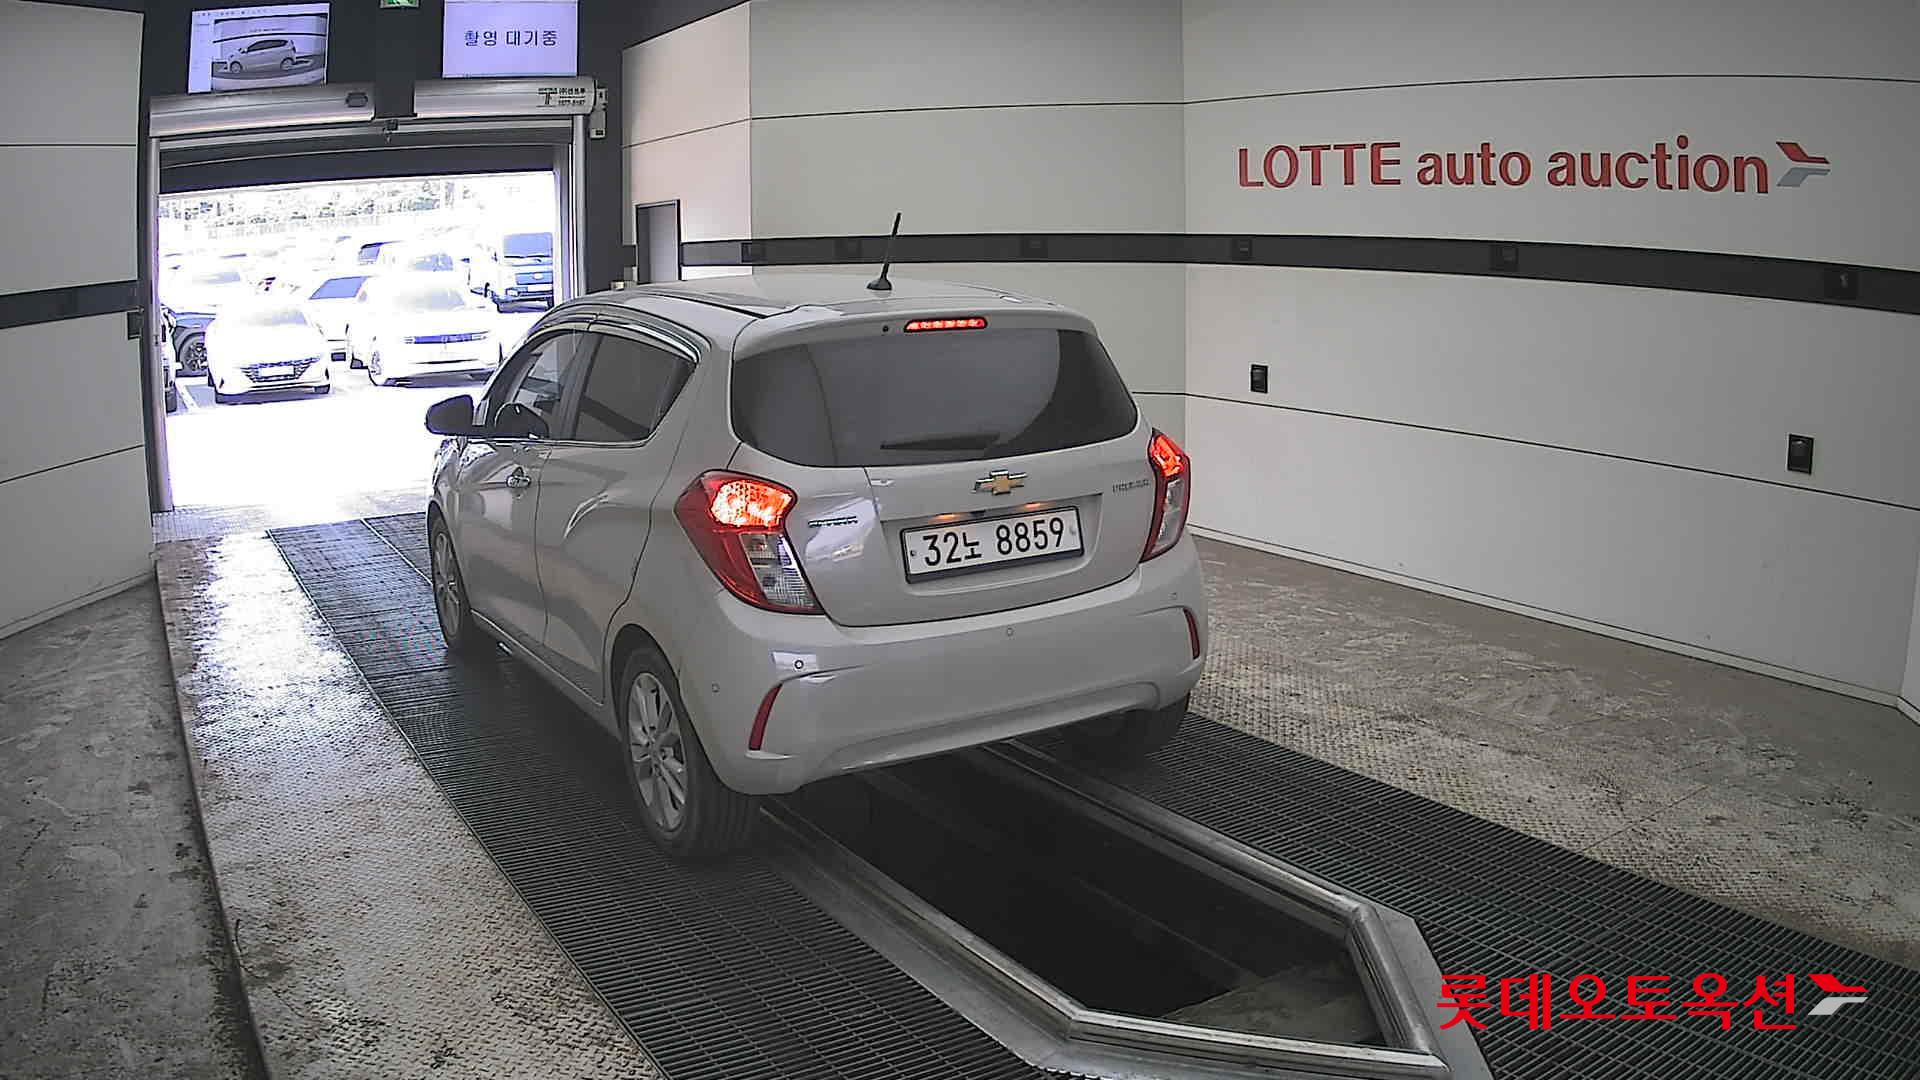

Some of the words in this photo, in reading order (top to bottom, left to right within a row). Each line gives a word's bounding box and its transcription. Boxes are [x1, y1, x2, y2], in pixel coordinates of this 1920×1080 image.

[464, 30, 497, 47] 촬영
[506, 30, 557, 46] 대기중
[1239, 143, 1399, 188] LOTTE
[1416, 142, 1532, 187] auto
[1547, 135, 1768, 193] auction
[923, 531, 982, 566] 32노
[996, 517, 1064, 555] 8859
